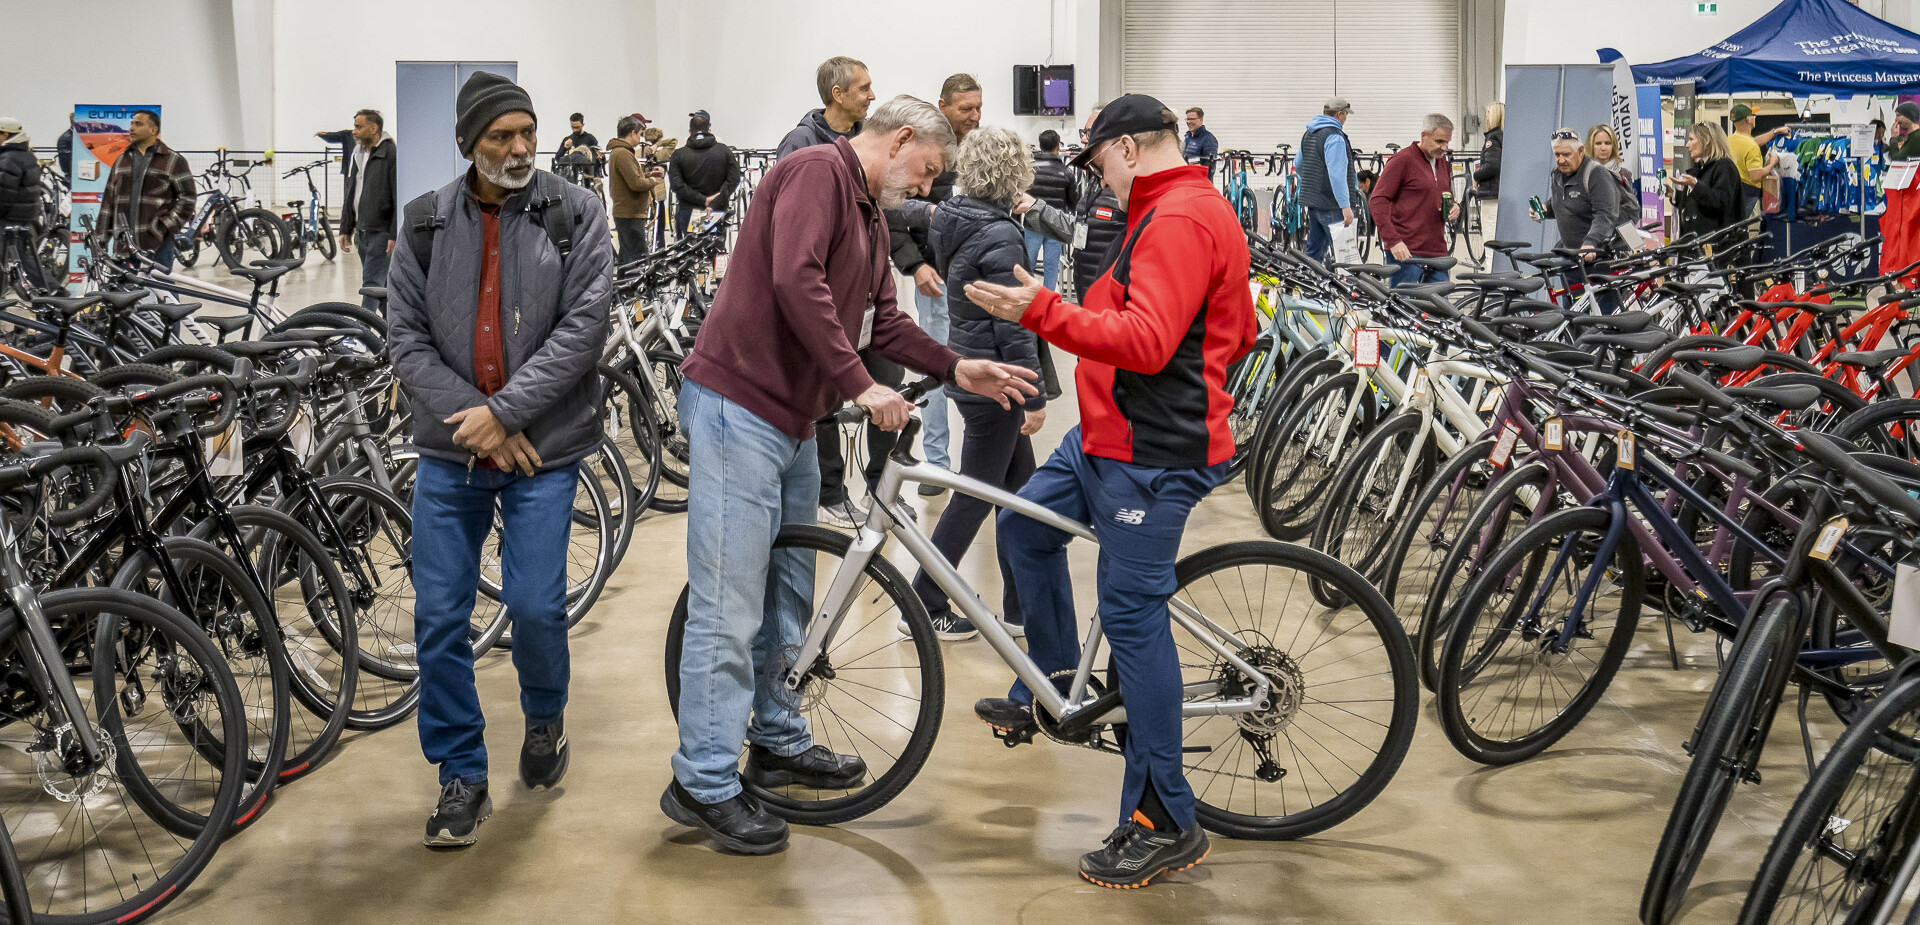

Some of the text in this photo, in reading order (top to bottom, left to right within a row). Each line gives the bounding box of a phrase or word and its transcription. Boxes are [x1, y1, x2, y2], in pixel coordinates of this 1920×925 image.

[1794, 31, 1900, 50] The Princess
[1797, 71, 1920, 85] The Princess Margar
[1619, 94, 1632, 150] TODAY
[1639, 137, 1647, 155] OU
